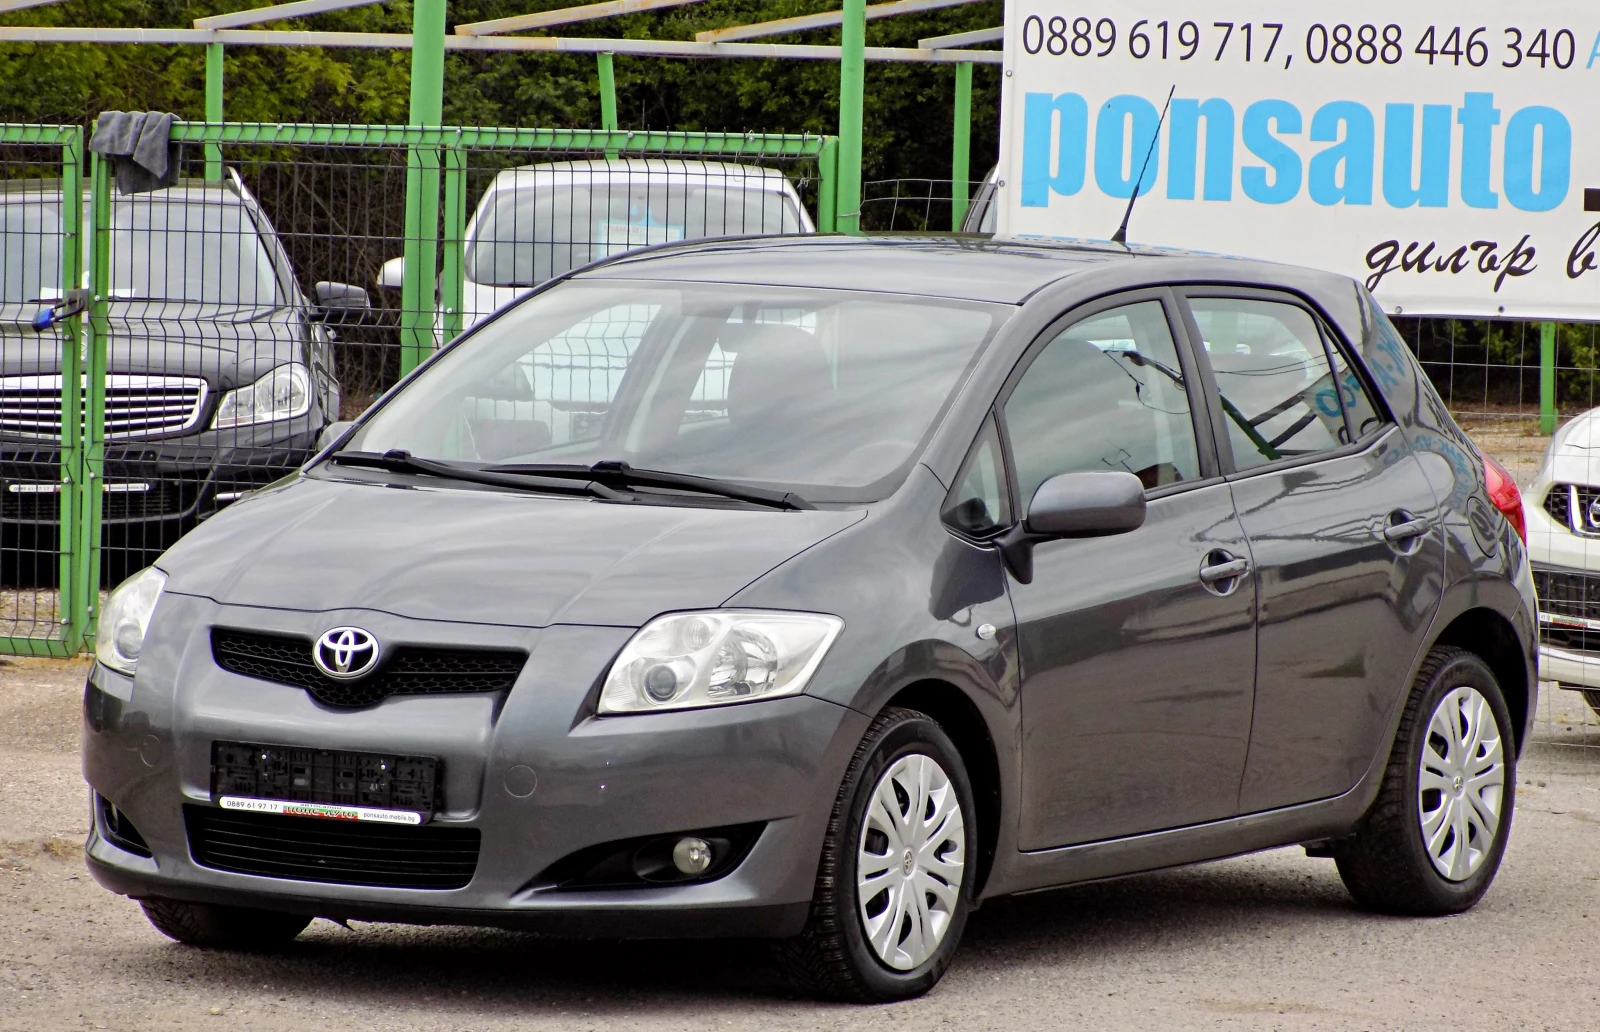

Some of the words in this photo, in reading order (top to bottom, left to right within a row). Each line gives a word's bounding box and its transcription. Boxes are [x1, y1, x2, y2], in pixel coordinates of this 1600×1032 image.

[1022, 14, 1117, 58] 0889
[1128, 19, 1200, 61] 619
[1213, 22, 1293, 70] 717,
[1306, 23, 1403, 64] 0888
[1414, 25, 1489, 67] 446
[1501, 27, 1576, 69] 340
[1020, 92, 1572, 212] ponsauto
[1365, 234, 1538, 292] дилър
[226, 800, 245, 808] 0889
[257, 802, 267, 810] 97
[363, 812, 416, 823] ponsauto.mobile.bg
